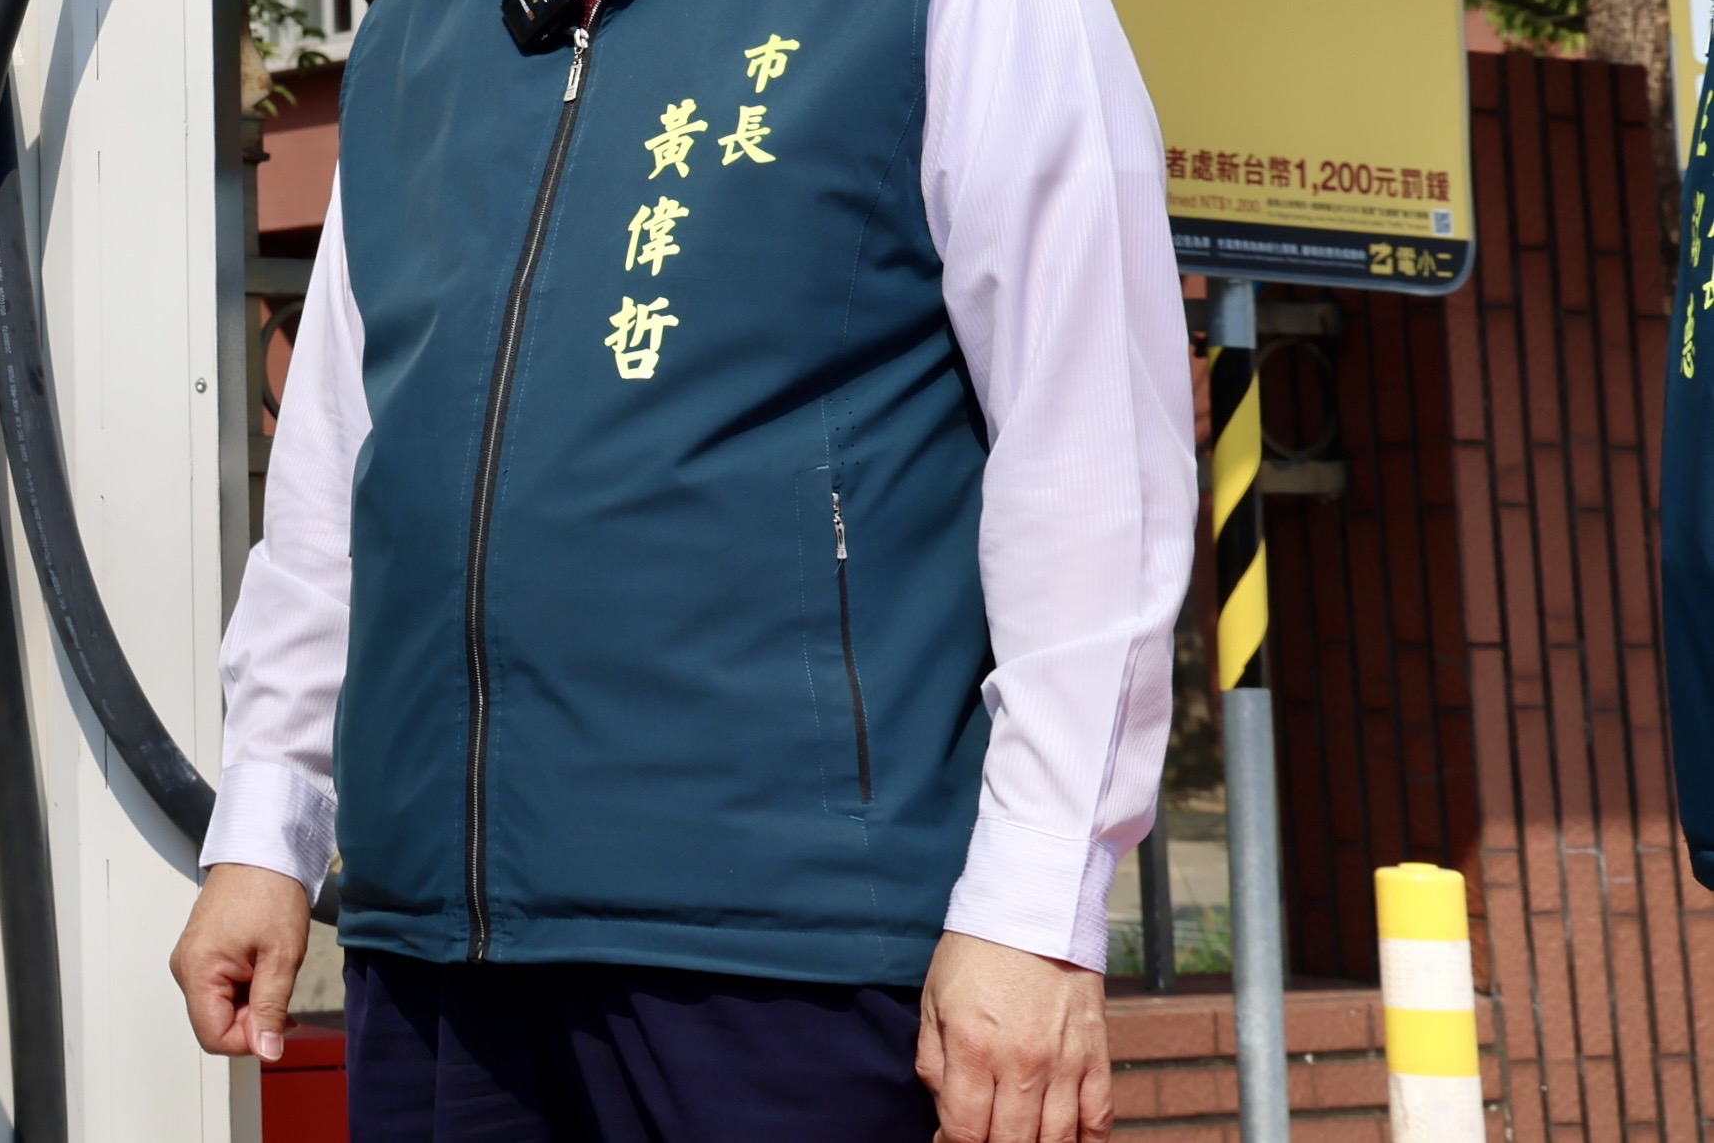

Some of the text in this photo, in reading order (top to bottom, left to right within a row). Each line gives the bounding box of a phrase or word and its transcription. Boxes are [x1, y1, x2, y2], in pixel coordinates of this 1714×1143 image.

[717, 33, 801, 166] 市長
[604, 98, 708, 380] 黃偉哲
[1395, 246, 1454, 279] 電小二
